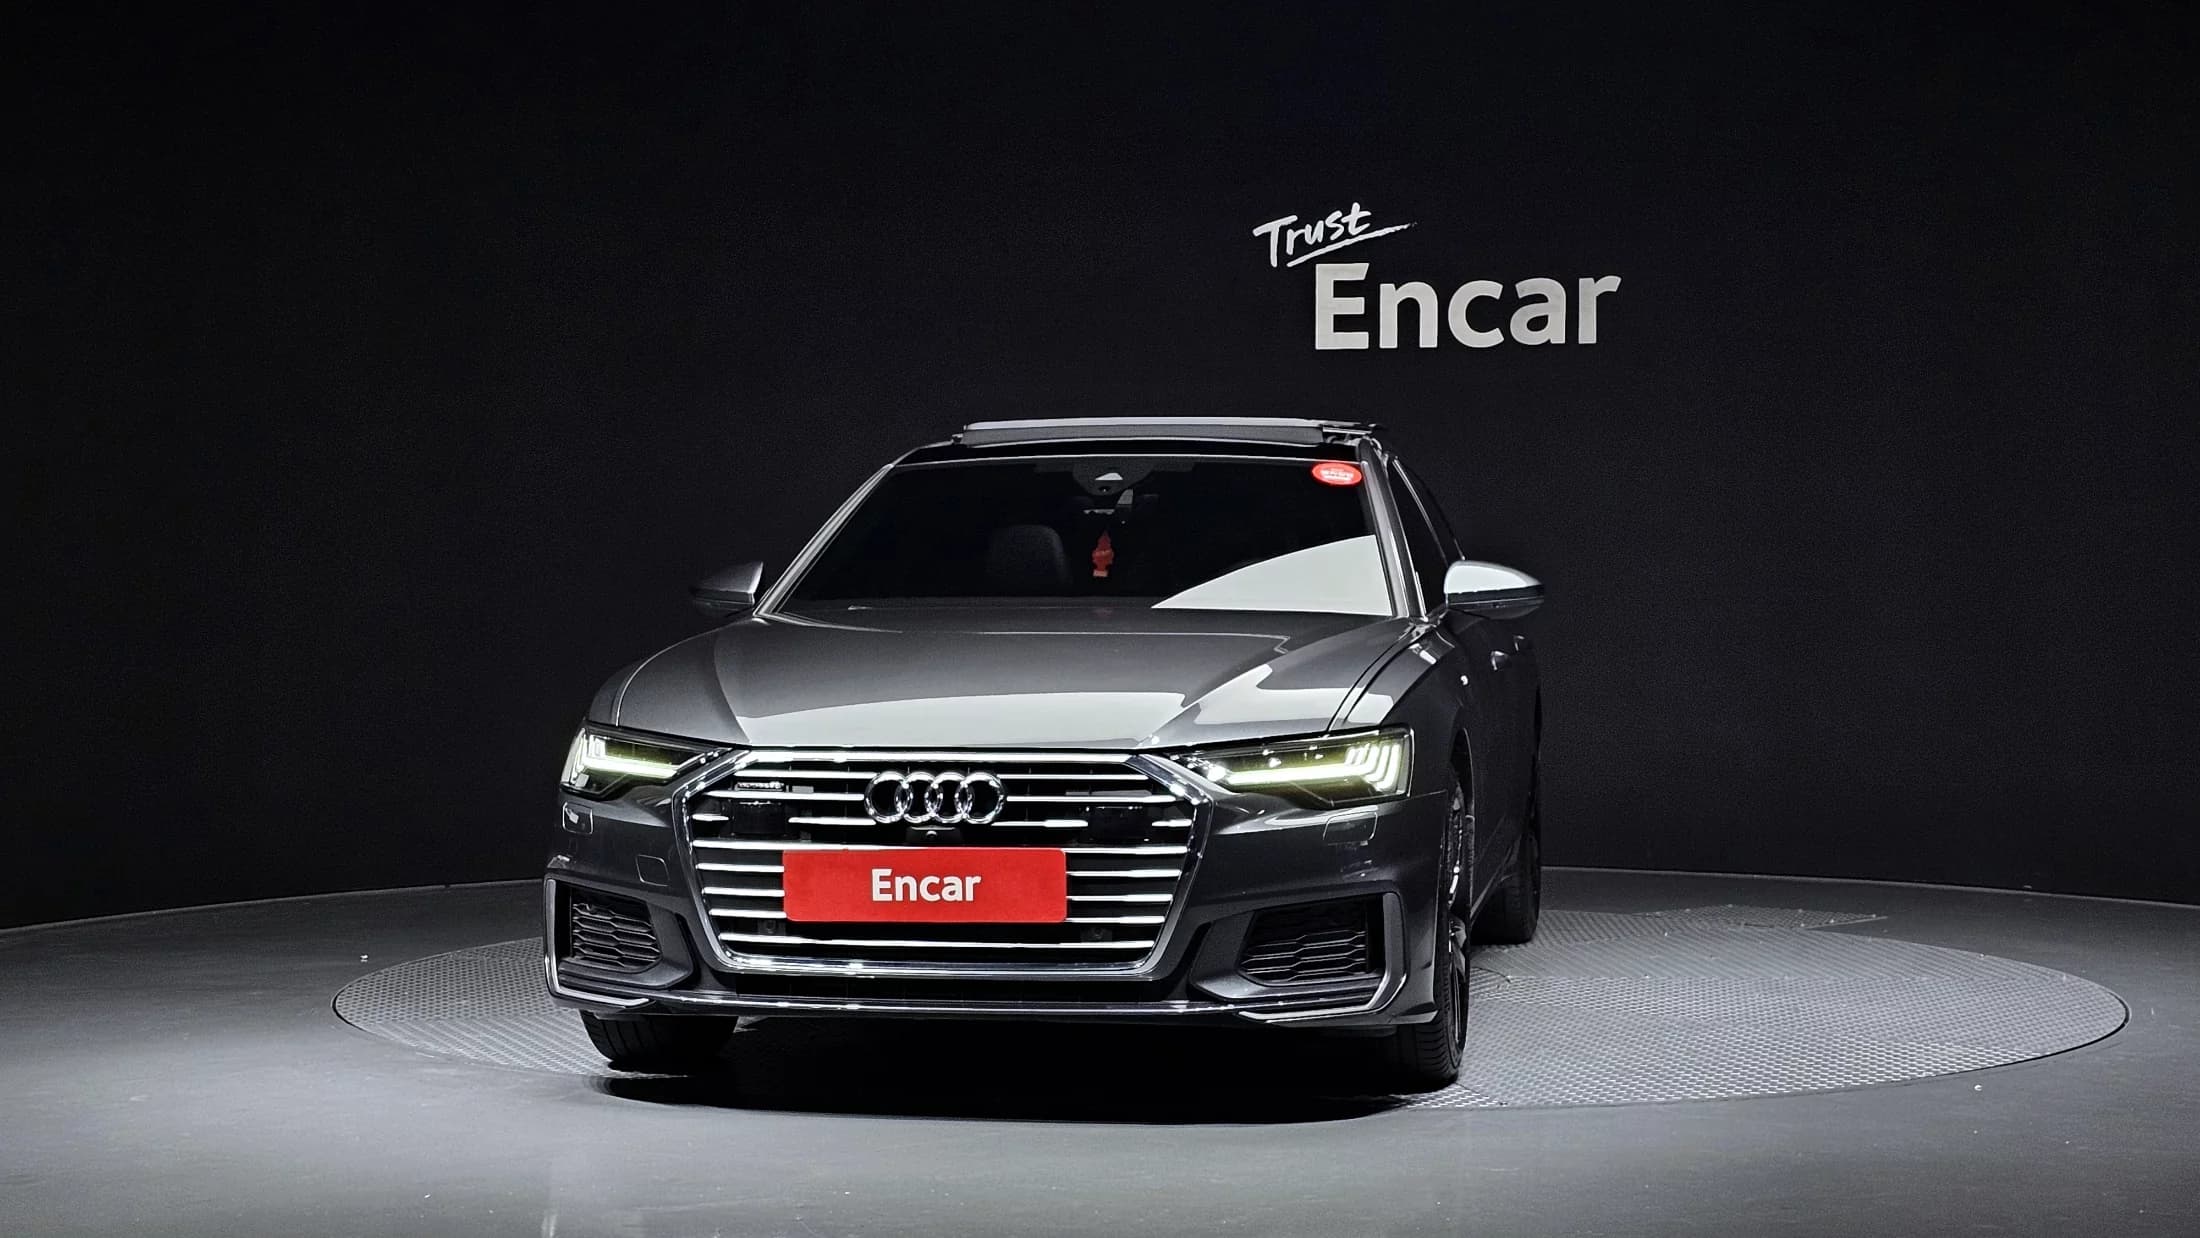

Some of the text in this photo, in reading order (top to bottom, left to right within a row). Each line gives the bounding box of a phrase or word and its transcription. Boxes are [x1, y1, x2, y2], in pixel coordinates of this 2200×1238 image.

[1253, 202, 1371, 267] Trust
[1315, 262, 1622, 350] Encar
[871, 868, 982, 902] Encar
